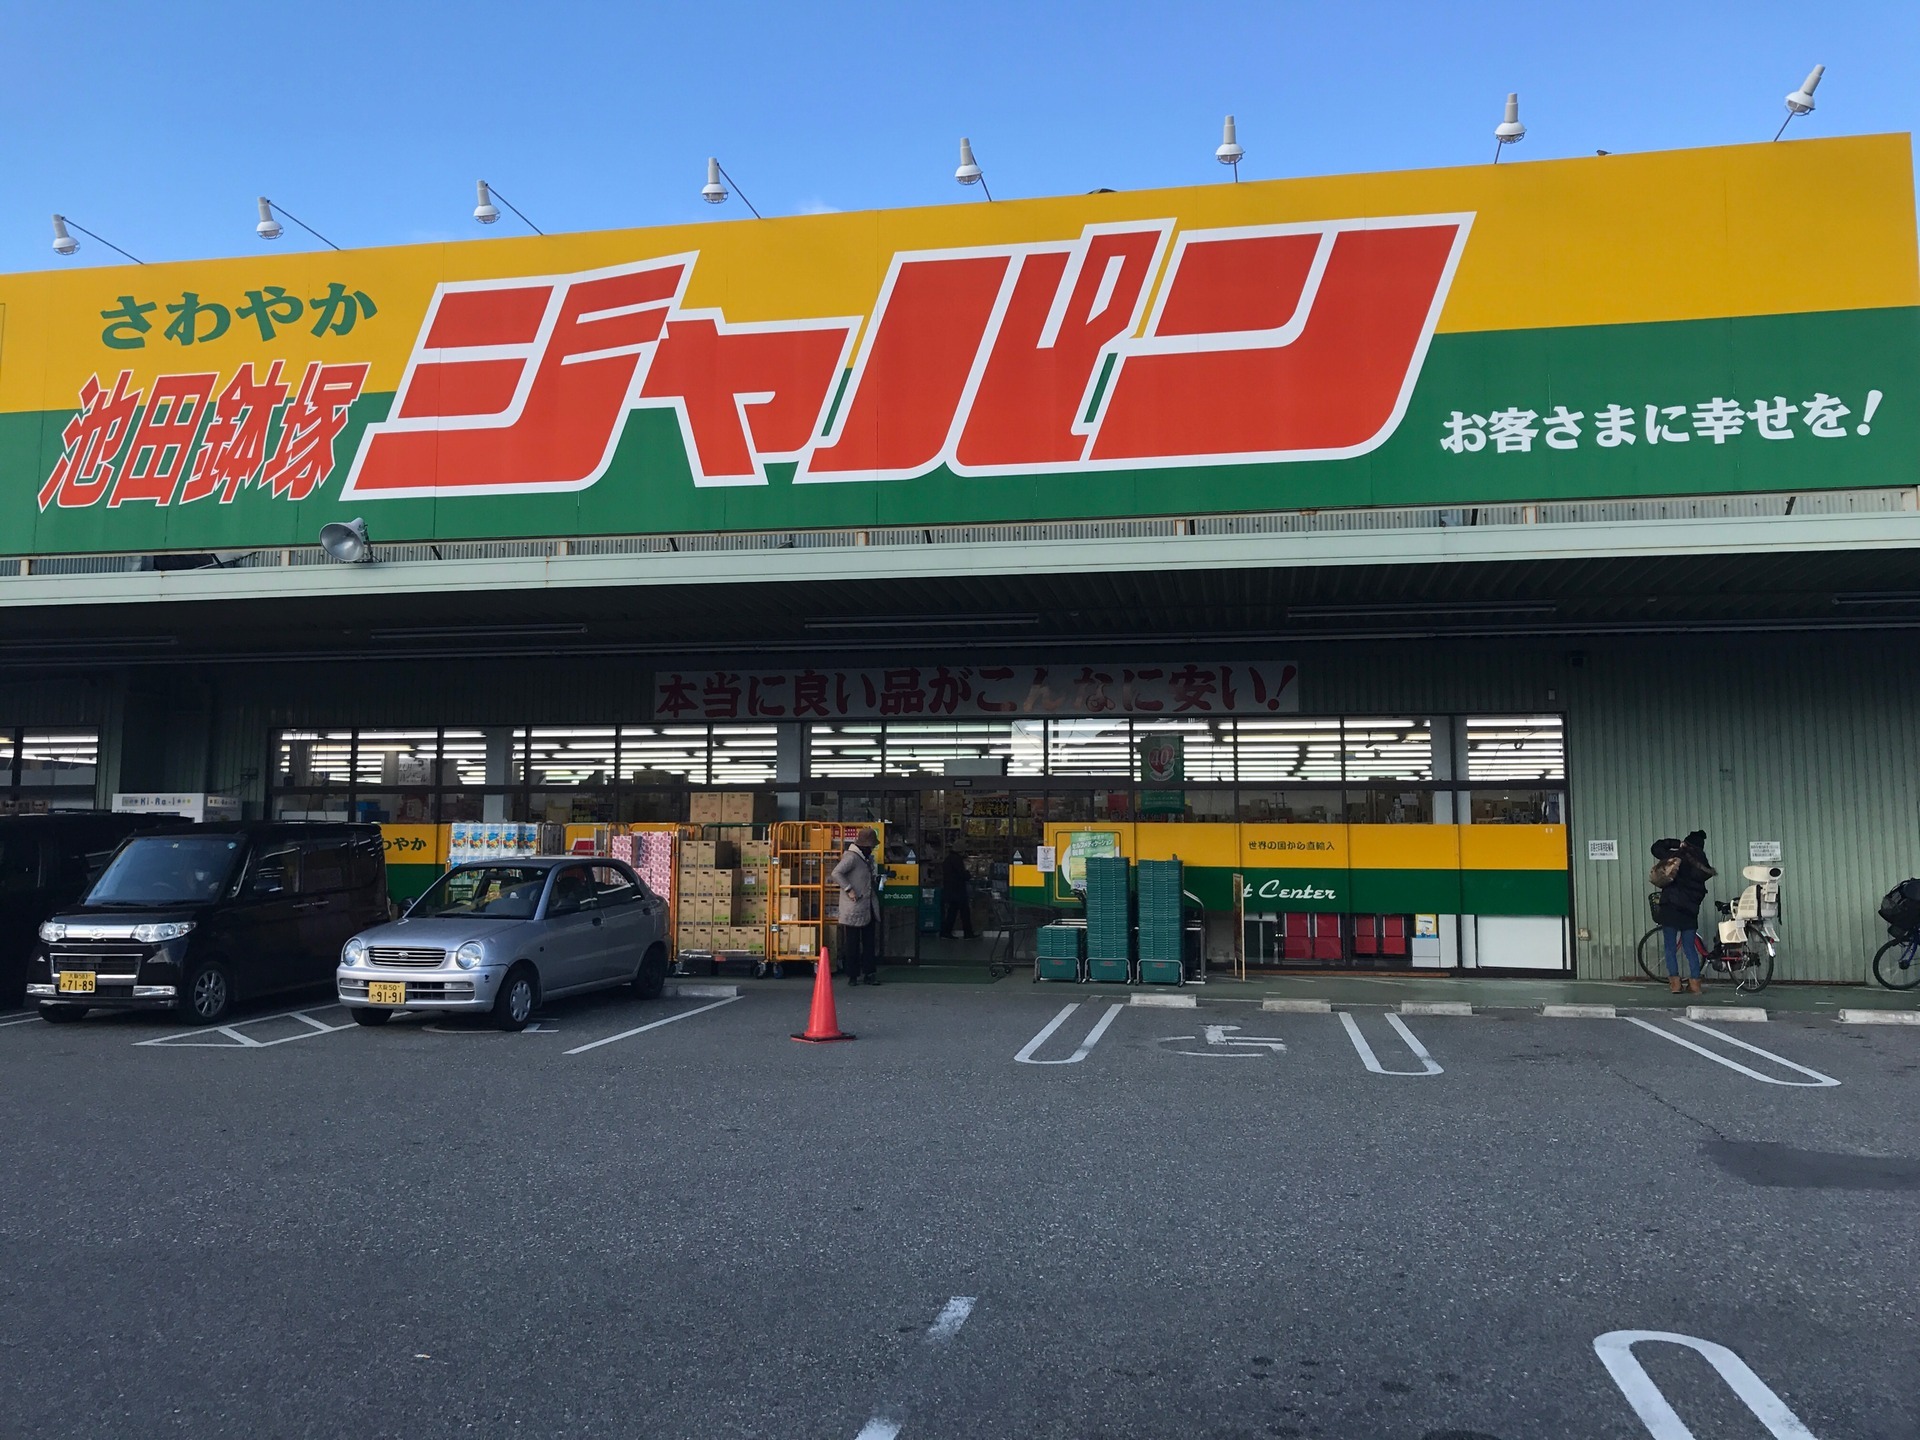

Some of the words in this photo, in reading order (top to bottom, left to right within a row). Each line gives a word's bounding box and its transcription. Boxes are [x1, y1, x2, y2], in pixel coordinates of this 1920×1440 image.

[100, 283, 378, 350] さわやか
[339, 210, 1479, 501] ジャパン
[37, 359, 372, 513] 池田鉢塚
[1248, 840, 1335, 851] 世界の国から直輸入
[1258, 879, 1337, 900] Center
[67, 980, 94, 991] 71-89
[376, 991, 402, 1003] 91-91
